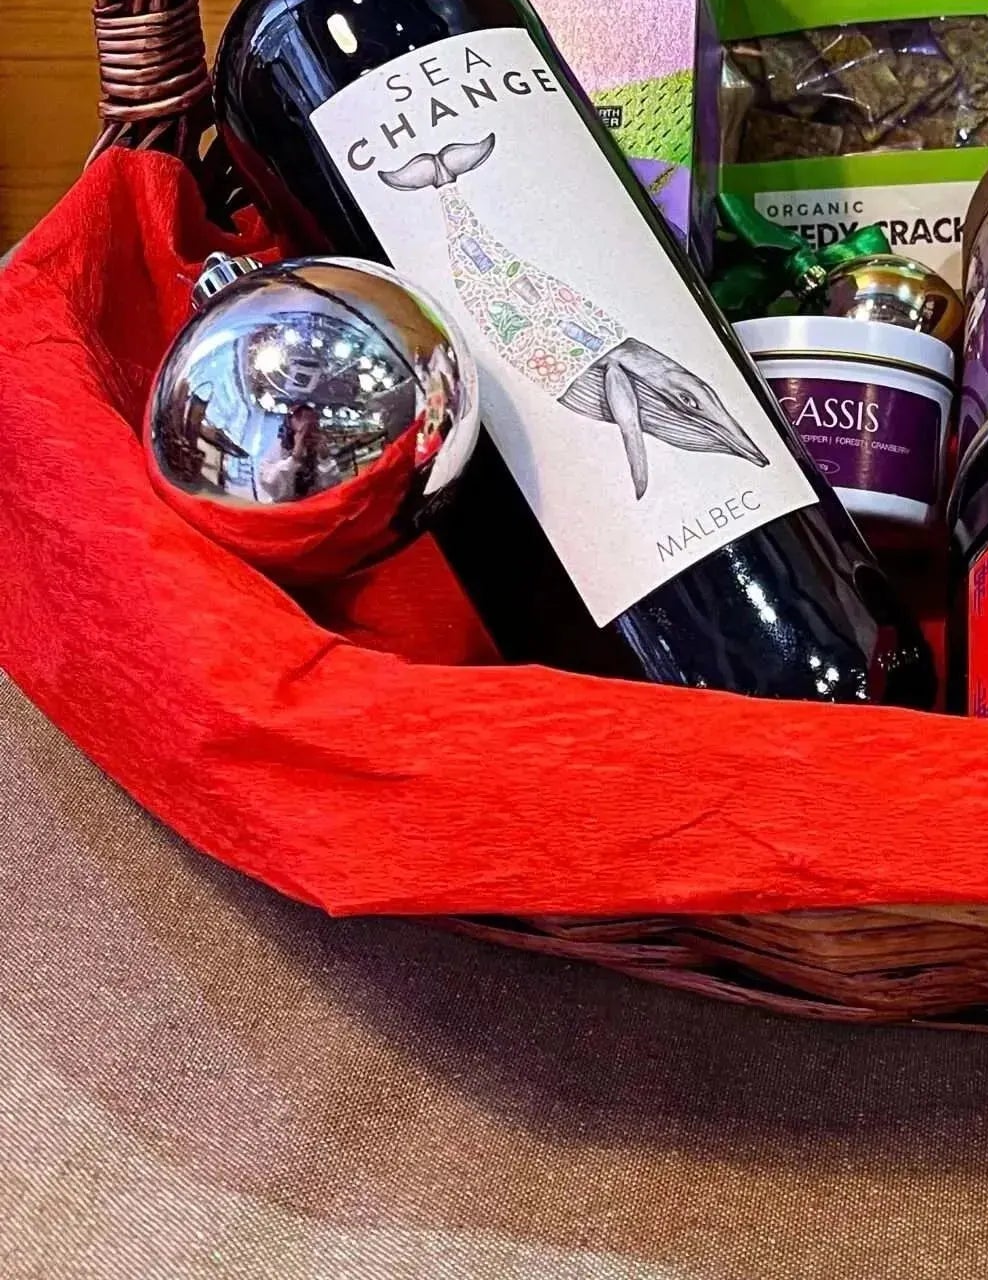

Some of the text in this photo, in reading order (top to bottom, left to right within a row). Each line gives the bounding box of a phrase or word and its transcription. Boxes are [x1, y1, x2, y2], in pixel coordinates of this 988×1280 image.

[386, 46, 492, 102] SEA
[347, 69, 557, 172] CHANGE
[767, 201, 864, 218] ORGANIC
[656, 490, 761, 562] MALBEC
